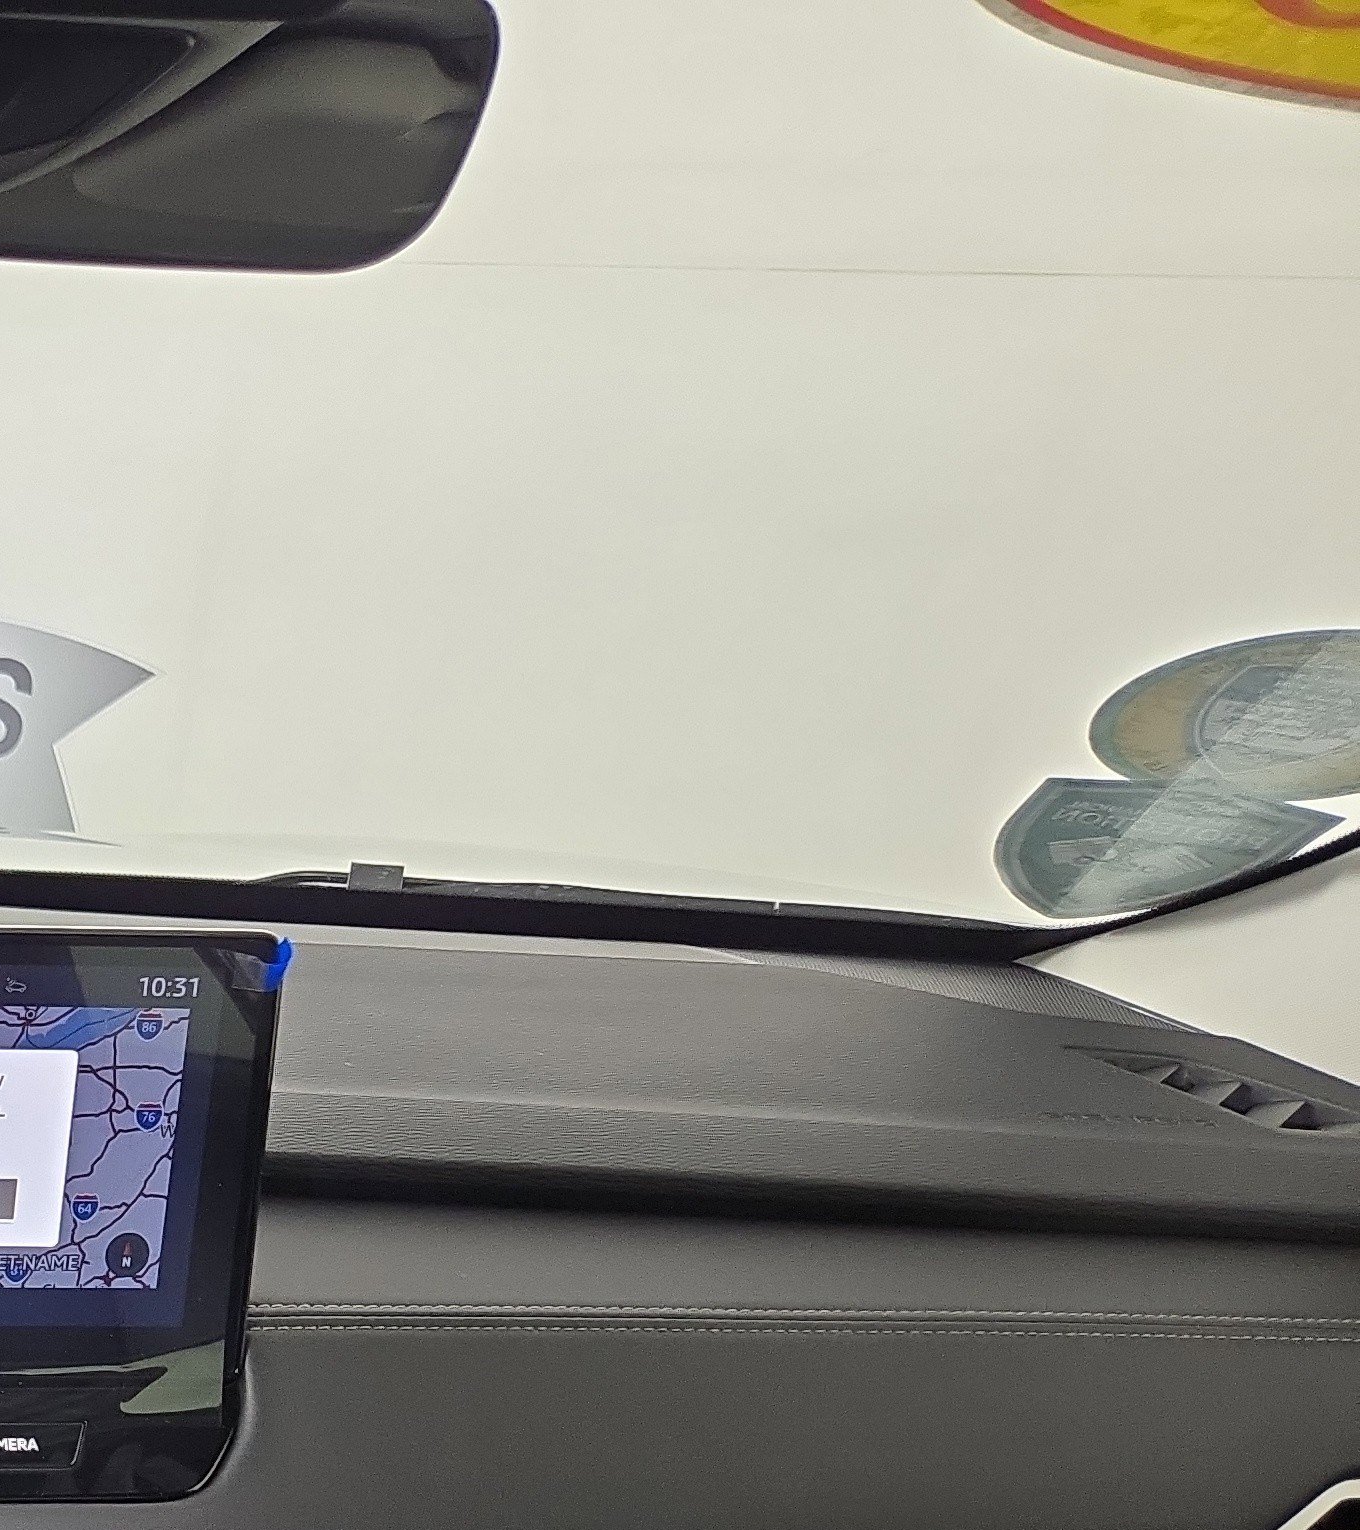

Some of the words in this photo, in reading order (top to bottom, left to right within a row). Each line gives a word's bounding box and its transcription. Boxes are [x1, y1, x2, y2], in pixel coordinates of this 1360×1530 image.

[139, 977, 200, 997] 10:31
[142, 1021, 157, 1034] 86
[142, 1112, 156, 1123] 76
[78, 1205, 92, 1214] 64
[24, 1254, 79, 1271] NAME
[122, 1257, 131, 1267] N
